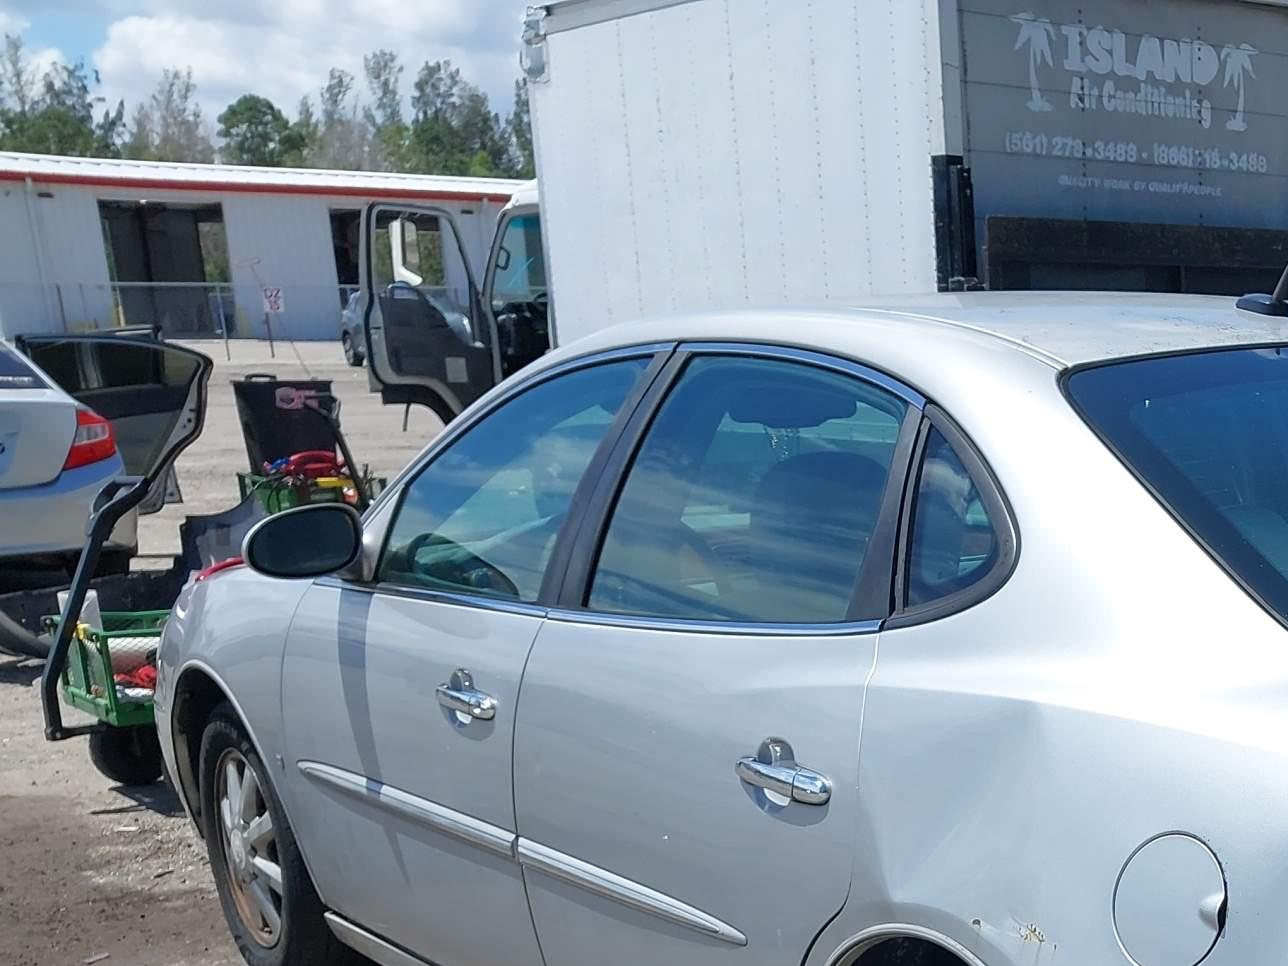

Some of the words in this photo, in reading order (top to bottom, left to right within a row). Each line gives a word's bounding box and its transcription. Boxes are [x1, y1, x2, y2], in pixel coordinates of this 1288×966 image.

[1060, 24, 1219, 85] ISLAND
[1069, 77, 1098, 110] Air
[1102, 80, 1212, 129] Conditioning
[1006, 131, 1047, 155] (561)
